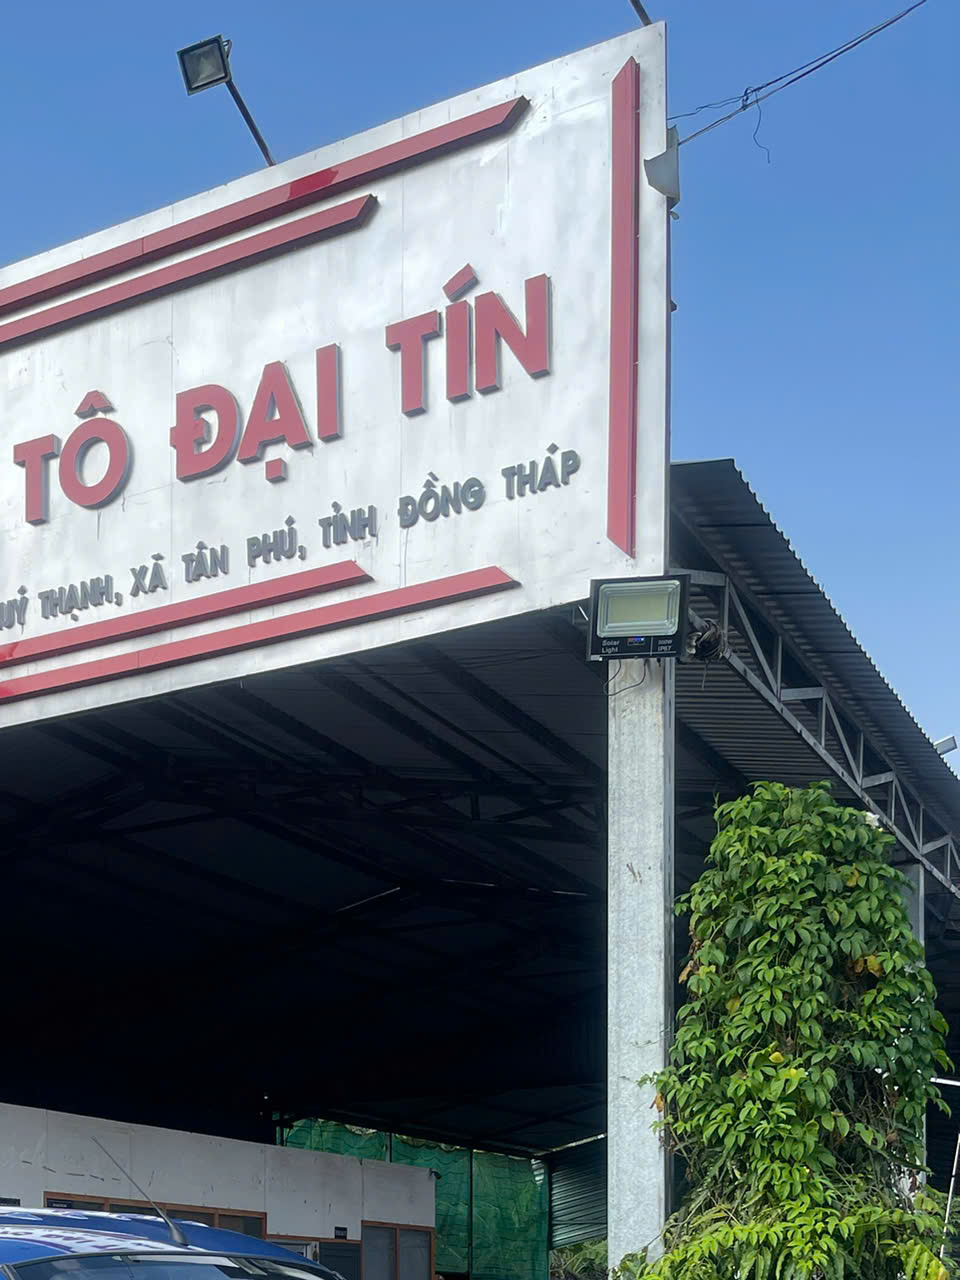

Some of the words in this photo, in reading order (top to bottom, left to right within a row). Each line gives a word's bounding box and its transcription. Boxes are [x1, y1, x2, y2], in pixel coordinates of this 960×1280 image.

[13, 390, 133, 526] TÔ
[170, 343, 343, 483] ĐẠI
[385, 263, 552, 418] TÍN
[182, 541, 230, 584] TÂN
[318, 501, 378, 549] TỈNH
[398, 471, 487, 530] ĐỒNG
[501, 442, 581, 500] THÁP
[602, 646, 619, 654] Light
